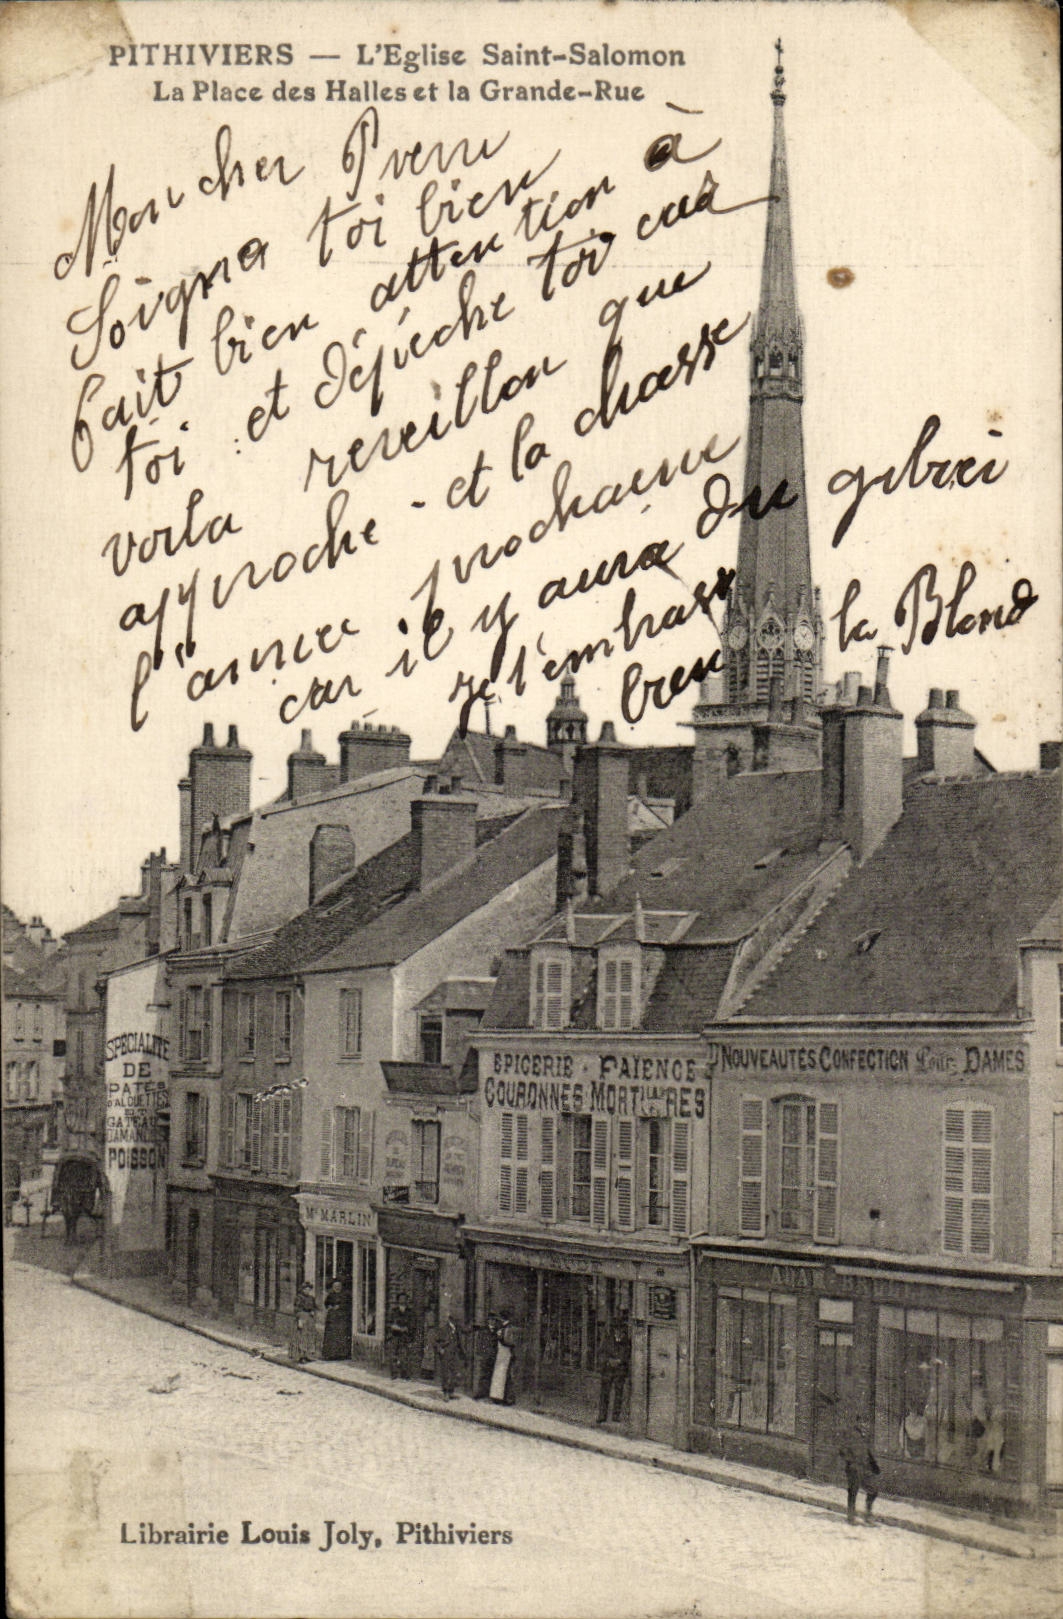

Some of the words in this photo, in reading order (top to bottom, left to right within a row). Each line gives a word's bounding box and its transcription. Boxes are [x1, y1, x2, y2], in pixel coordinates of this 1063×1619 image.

[199, 125, 306, 201] cher
[307, 193, 387, 267] toi
[416, 149, 562, 237] bien
[72, 353, 195, 472] fait
[211, 304, 319, 375] bien
[116, 421, 189, 500] toi
[247, 368, 290, 441] et
[446, 450, 493, 508] et
[511, 413, 551, 482] la
[280, 675, 362, 724] car
[471, 592, 519, 684] y
[538, 540, 685, 609] aura
[696, 473, 798, 539] du
[123, 1062, 151, 1077] DE
[485, 1076, 583, 1112] COURONNES
[963, 1046, 1025, 1074] DAMES
[108, 1148, 166, 1170] POISSON
